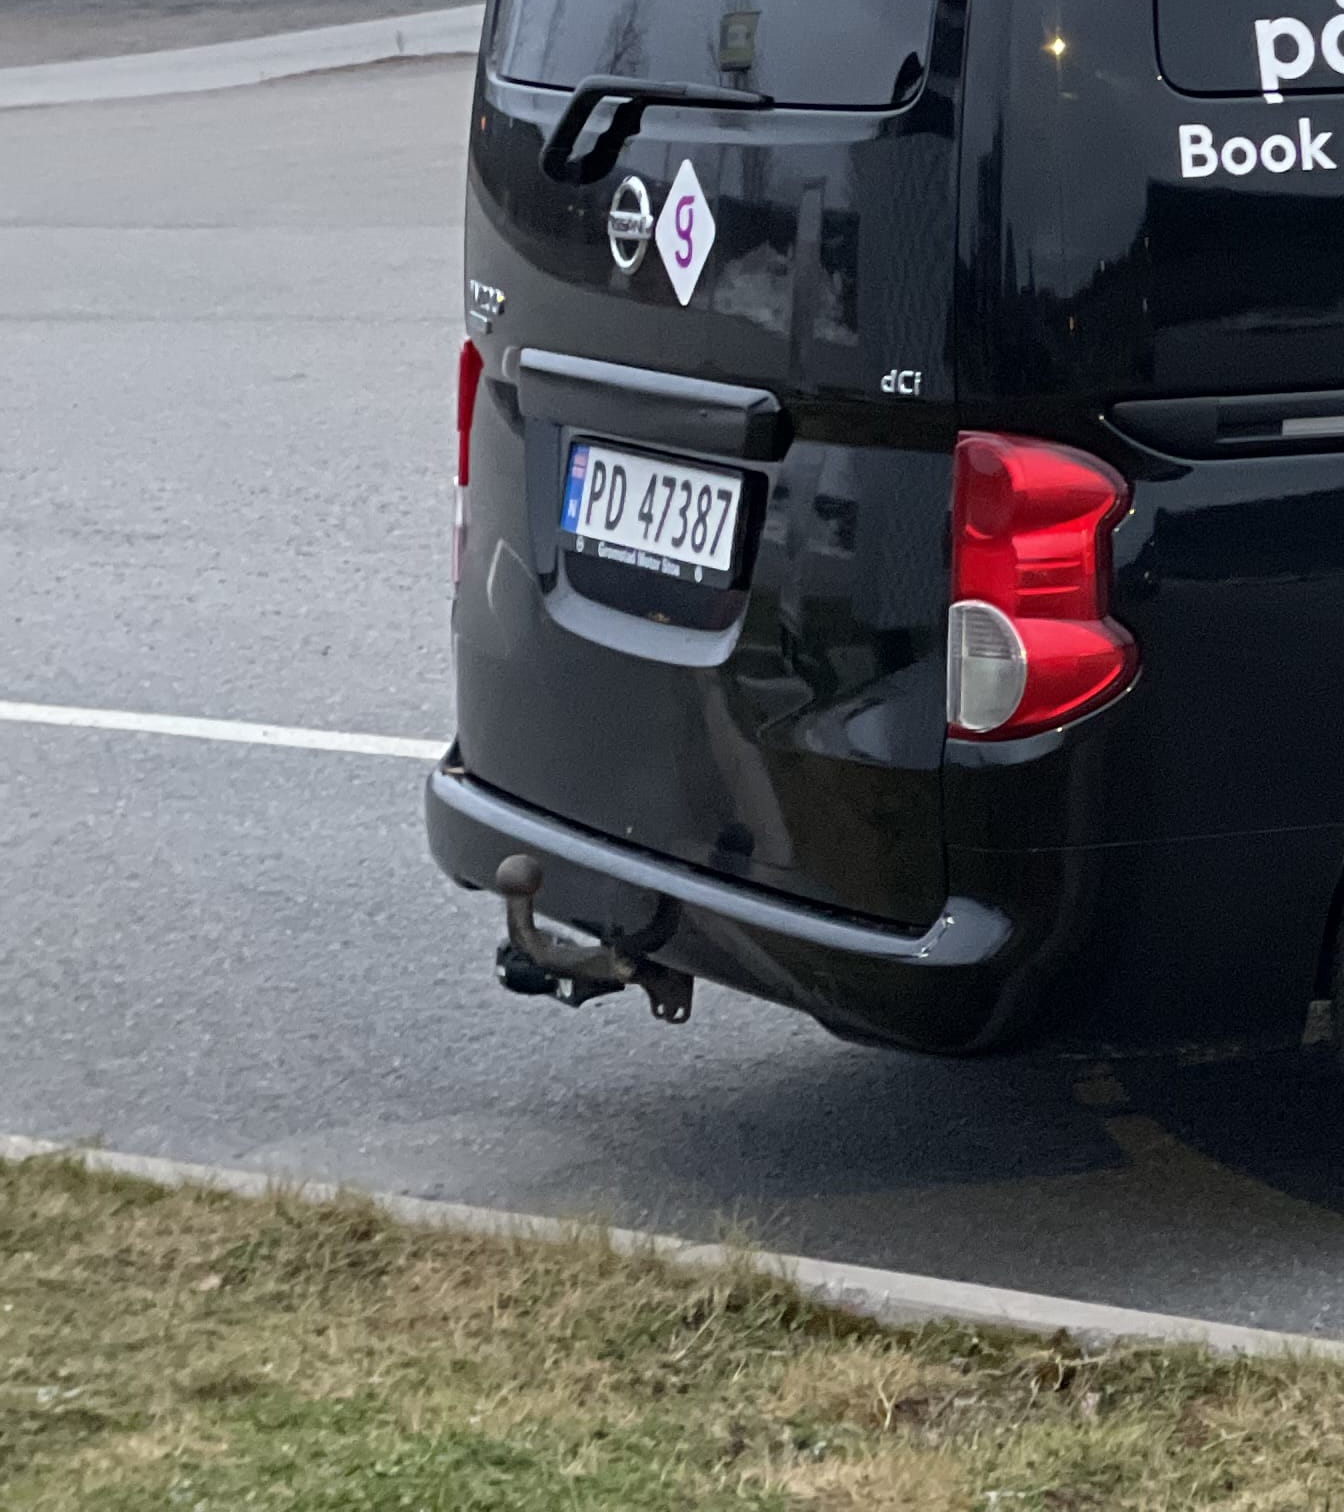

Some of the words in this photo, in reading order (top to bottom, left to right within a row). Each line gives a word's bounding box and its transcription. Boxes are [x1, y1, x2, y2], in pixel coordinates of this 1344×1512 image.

[1178, 117, 1337, 178] Book
[880, 369, 922, 396] dCi
[585, 459, 627, 531] PD
[637, 472, 733, 557] 47387
